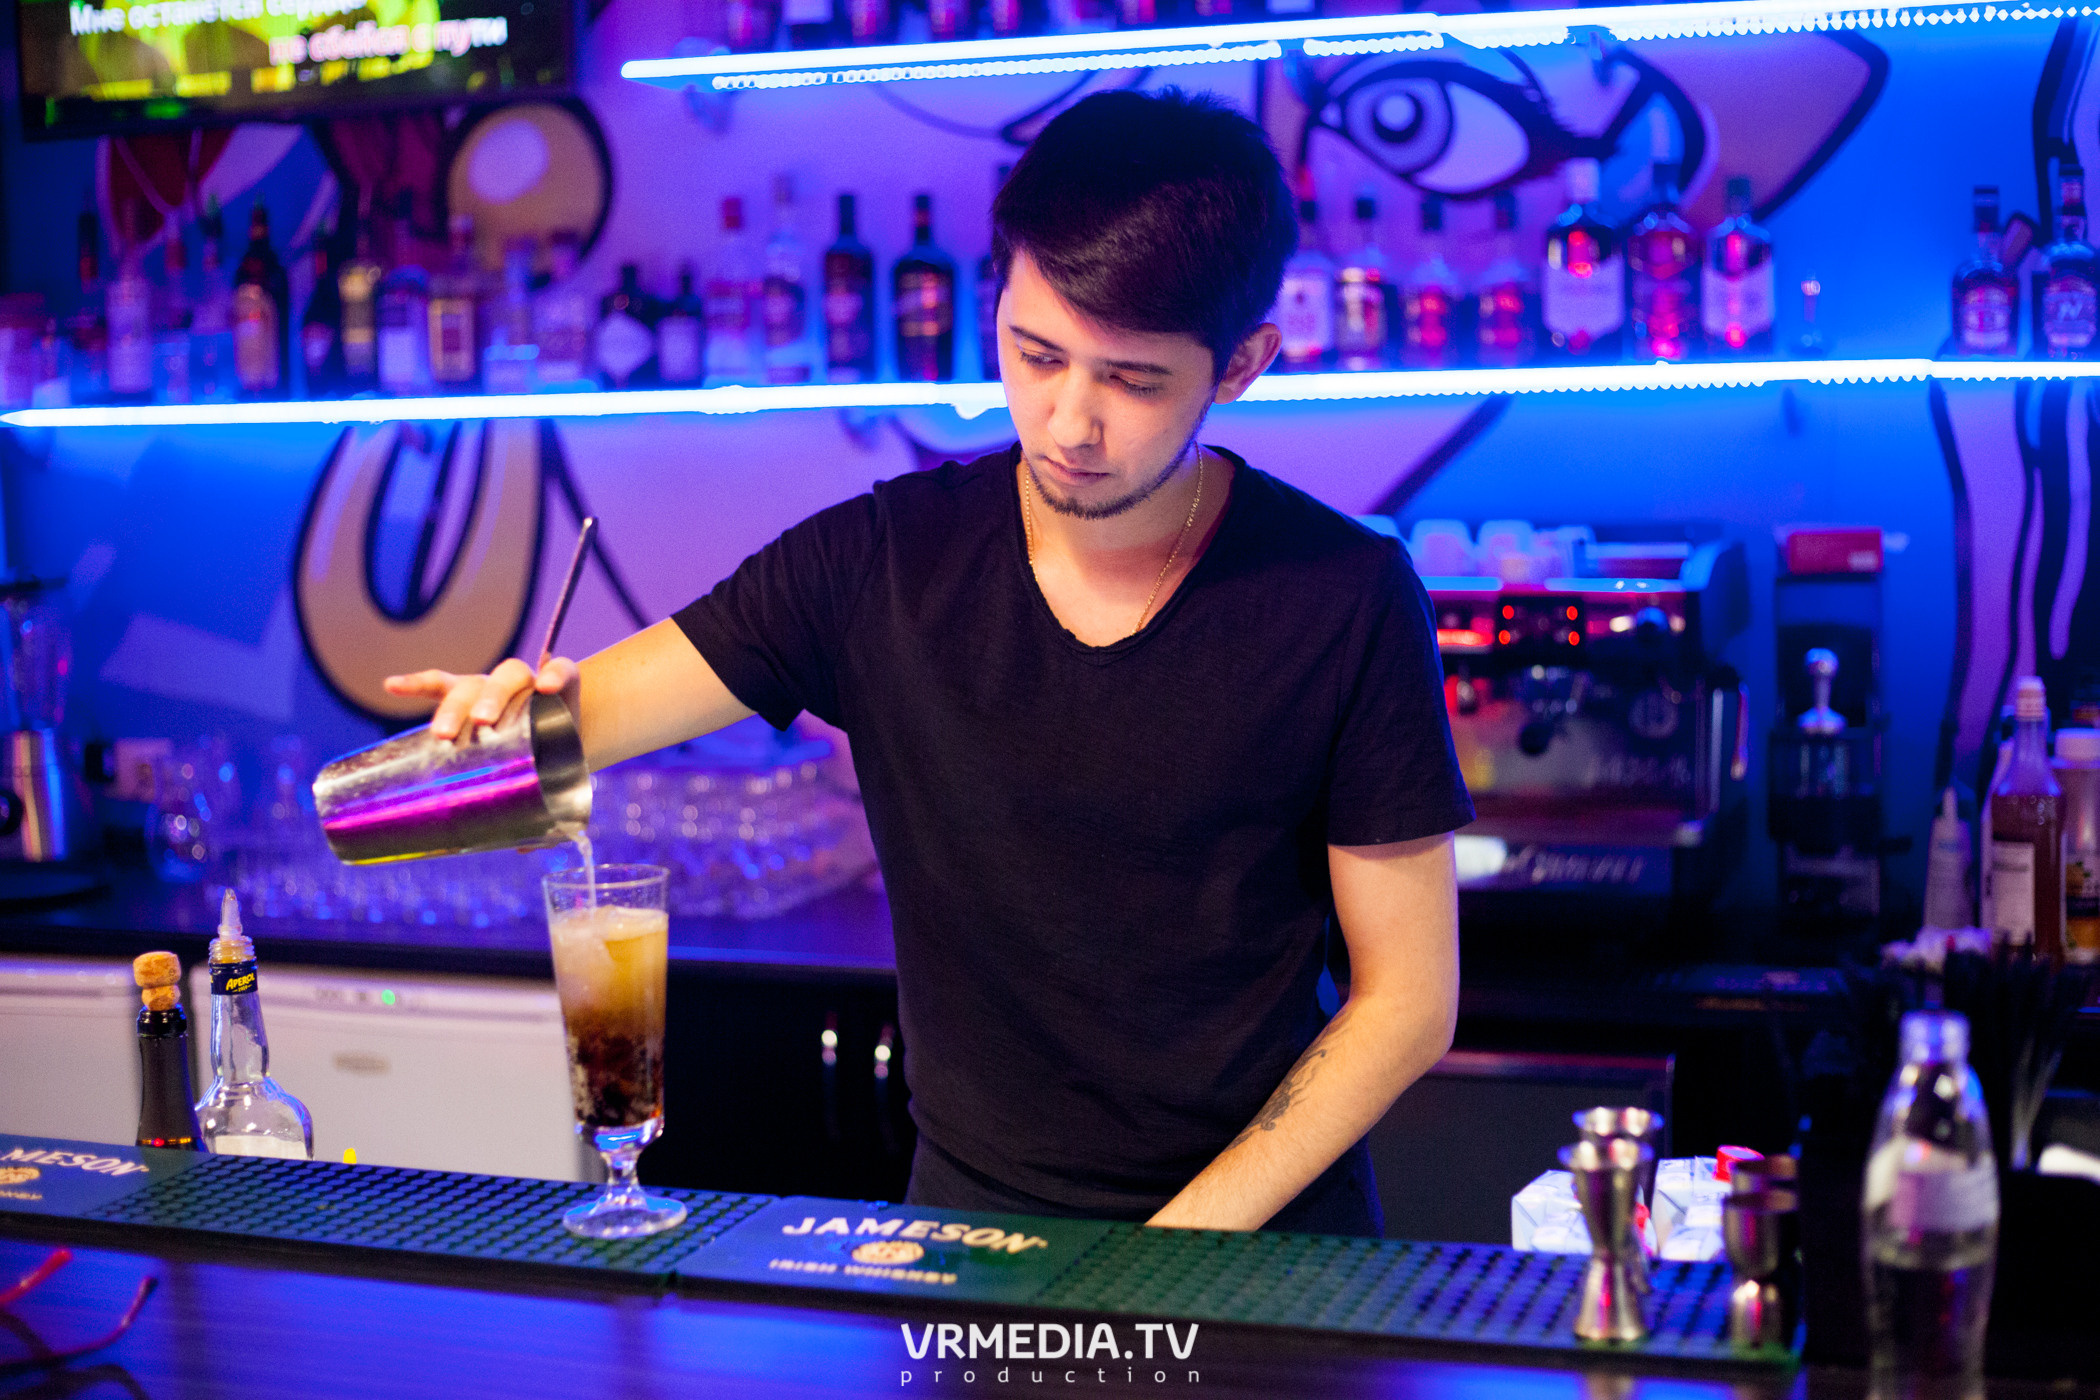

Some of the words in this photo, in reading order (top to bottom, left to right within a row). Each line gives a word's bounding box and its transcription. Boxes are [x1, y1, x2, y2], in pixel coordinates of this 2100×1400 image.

[69, 4, 126, 35] Мне
[225, 972, 255, 991] APEROL
[781, 1217, 1043, 1254] JAMESON
